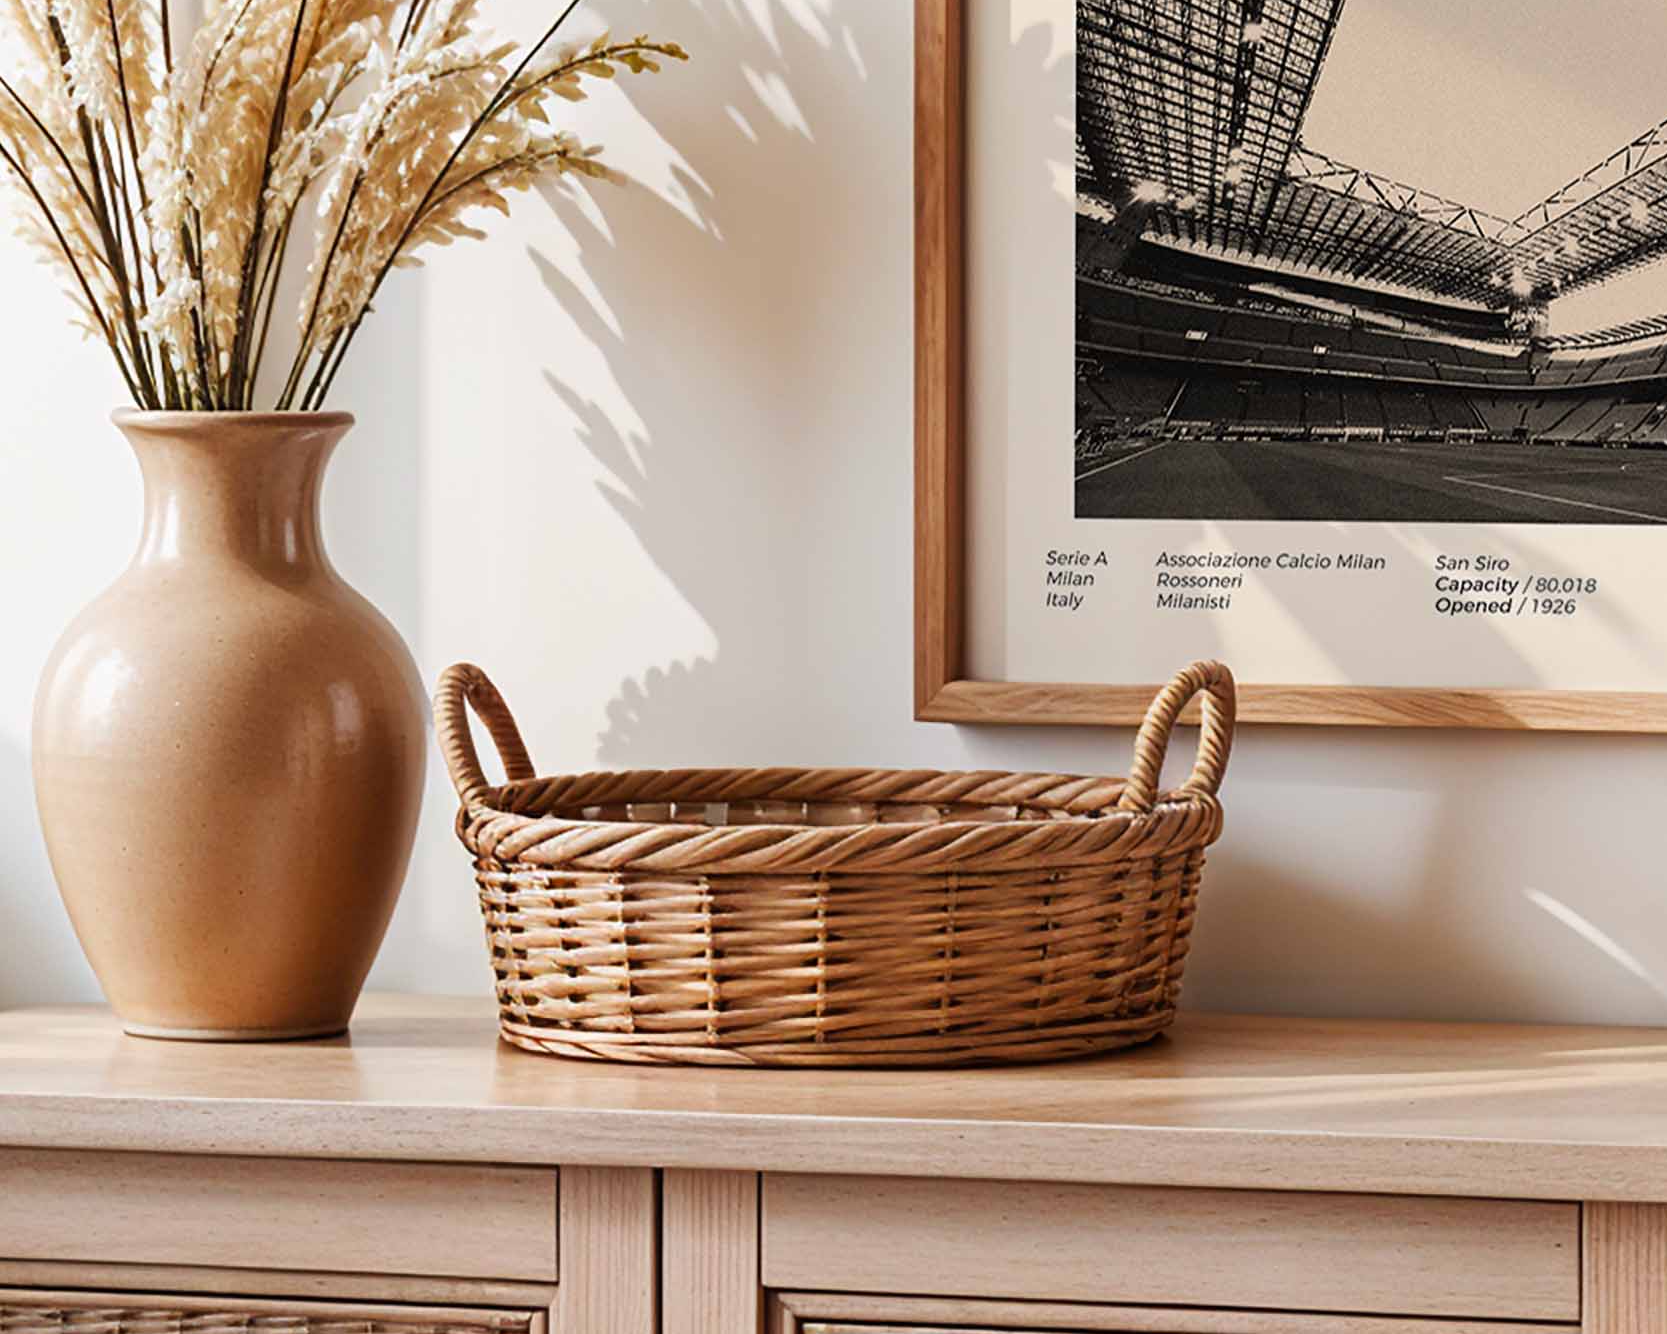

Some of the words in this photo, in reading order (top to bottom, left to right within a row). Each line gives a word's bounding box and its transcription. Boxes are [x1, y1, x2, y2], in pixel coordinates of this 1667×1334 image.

[1046, 550, 1090, 566] Serie
[1093, 551, 1108, 566] A
[1155, 552, 1271, 569] Associazione
[1276, 553, 1331, 569] Calcio
[1336, 554, 1385, 570] Milan
[1435, 555, 1469, 571] San
[1474, 555, 1510, 572] Siro
[1047, 571, 1094, 586] Milan
[1156, 572, 1243, 588] Rossoneri
[1435, 576, 1519, 596] Capacity
[1522, 575, 1534, 594] /
[1046, 592, 1084, 611] Italy
[1157, 593, 1231, 610] Milanisti
[1435, 597, 1512, 616] Opened
[1516, 597, 1528, 615] /
[1533, 598, 1576, 615] 1926
